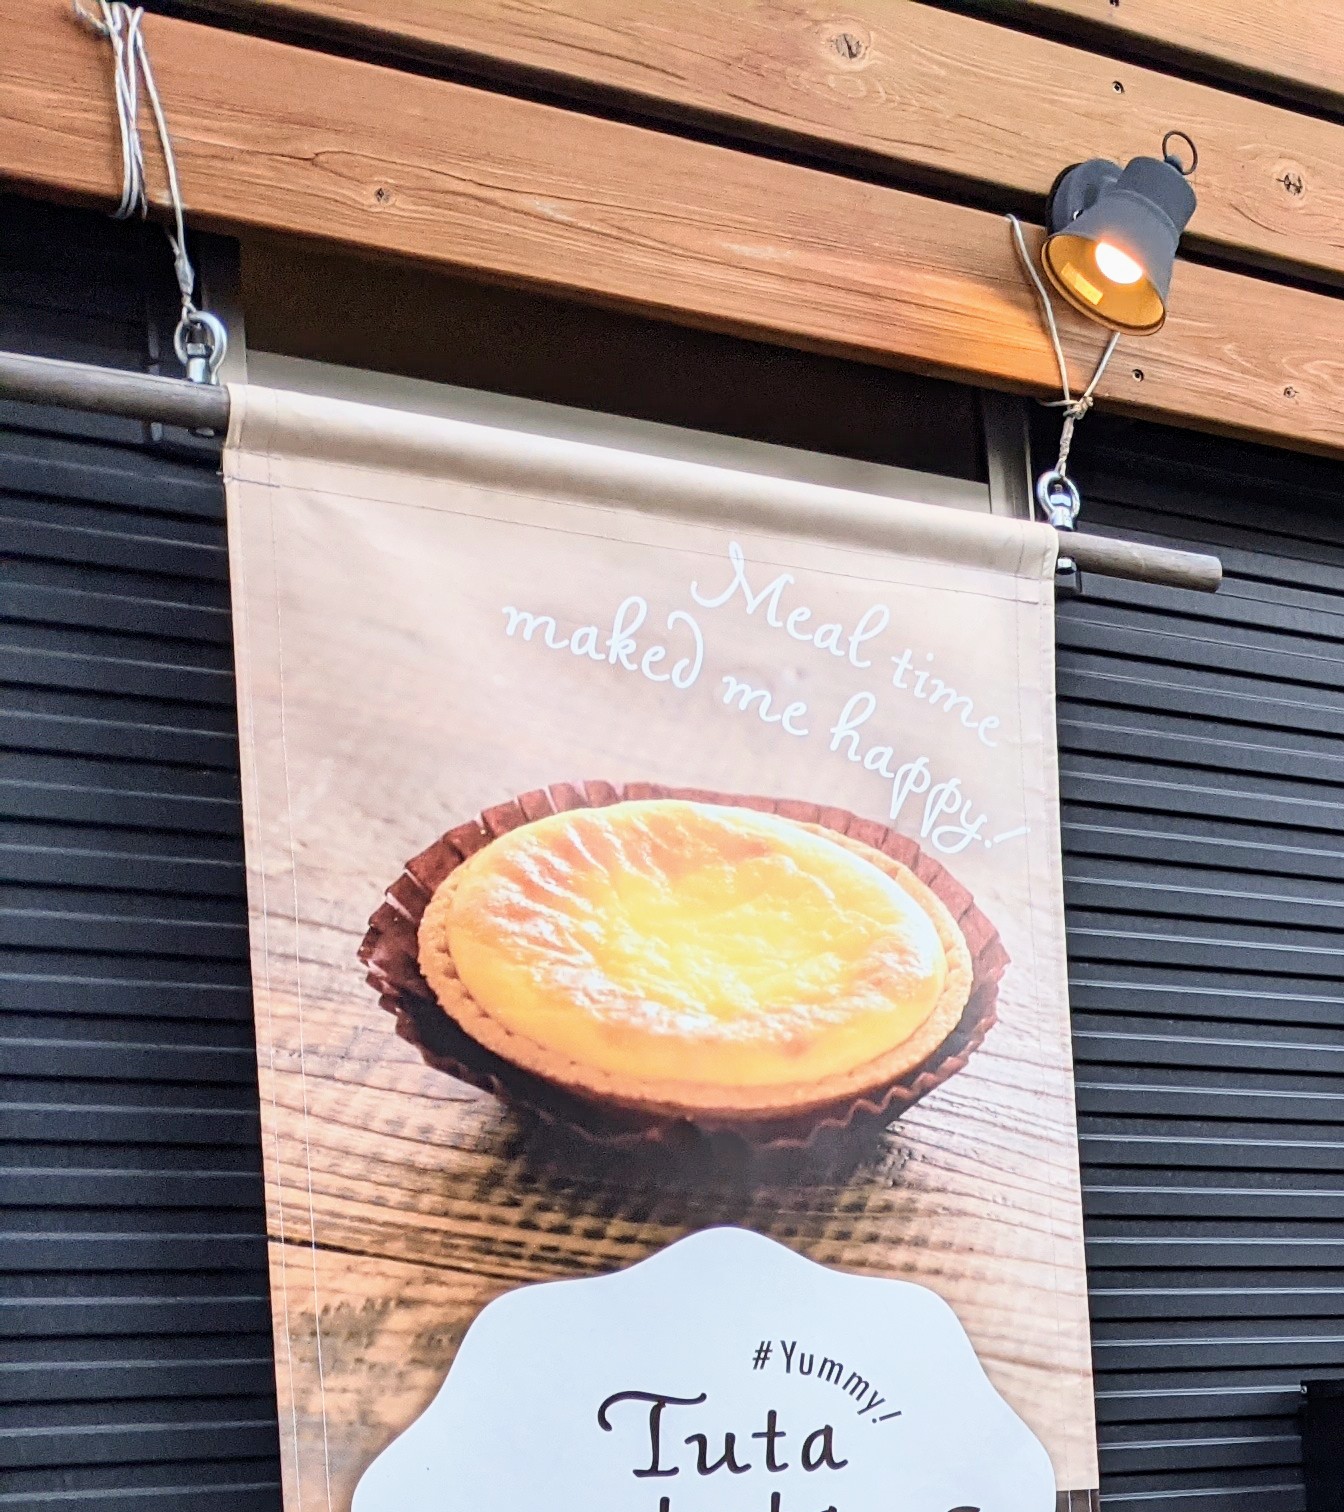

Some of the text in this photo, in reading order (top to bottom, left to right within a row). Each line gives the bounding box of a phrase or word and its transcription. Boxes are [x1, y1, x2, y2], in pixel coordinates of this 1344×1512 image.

[690, 540, 1001, 748] Meal time
[501, 596, 1032, 854] maked me happy!
[597, 1390, 849, 1478] Tuta
[751, 1340, 903, 1424] #Yummy!
